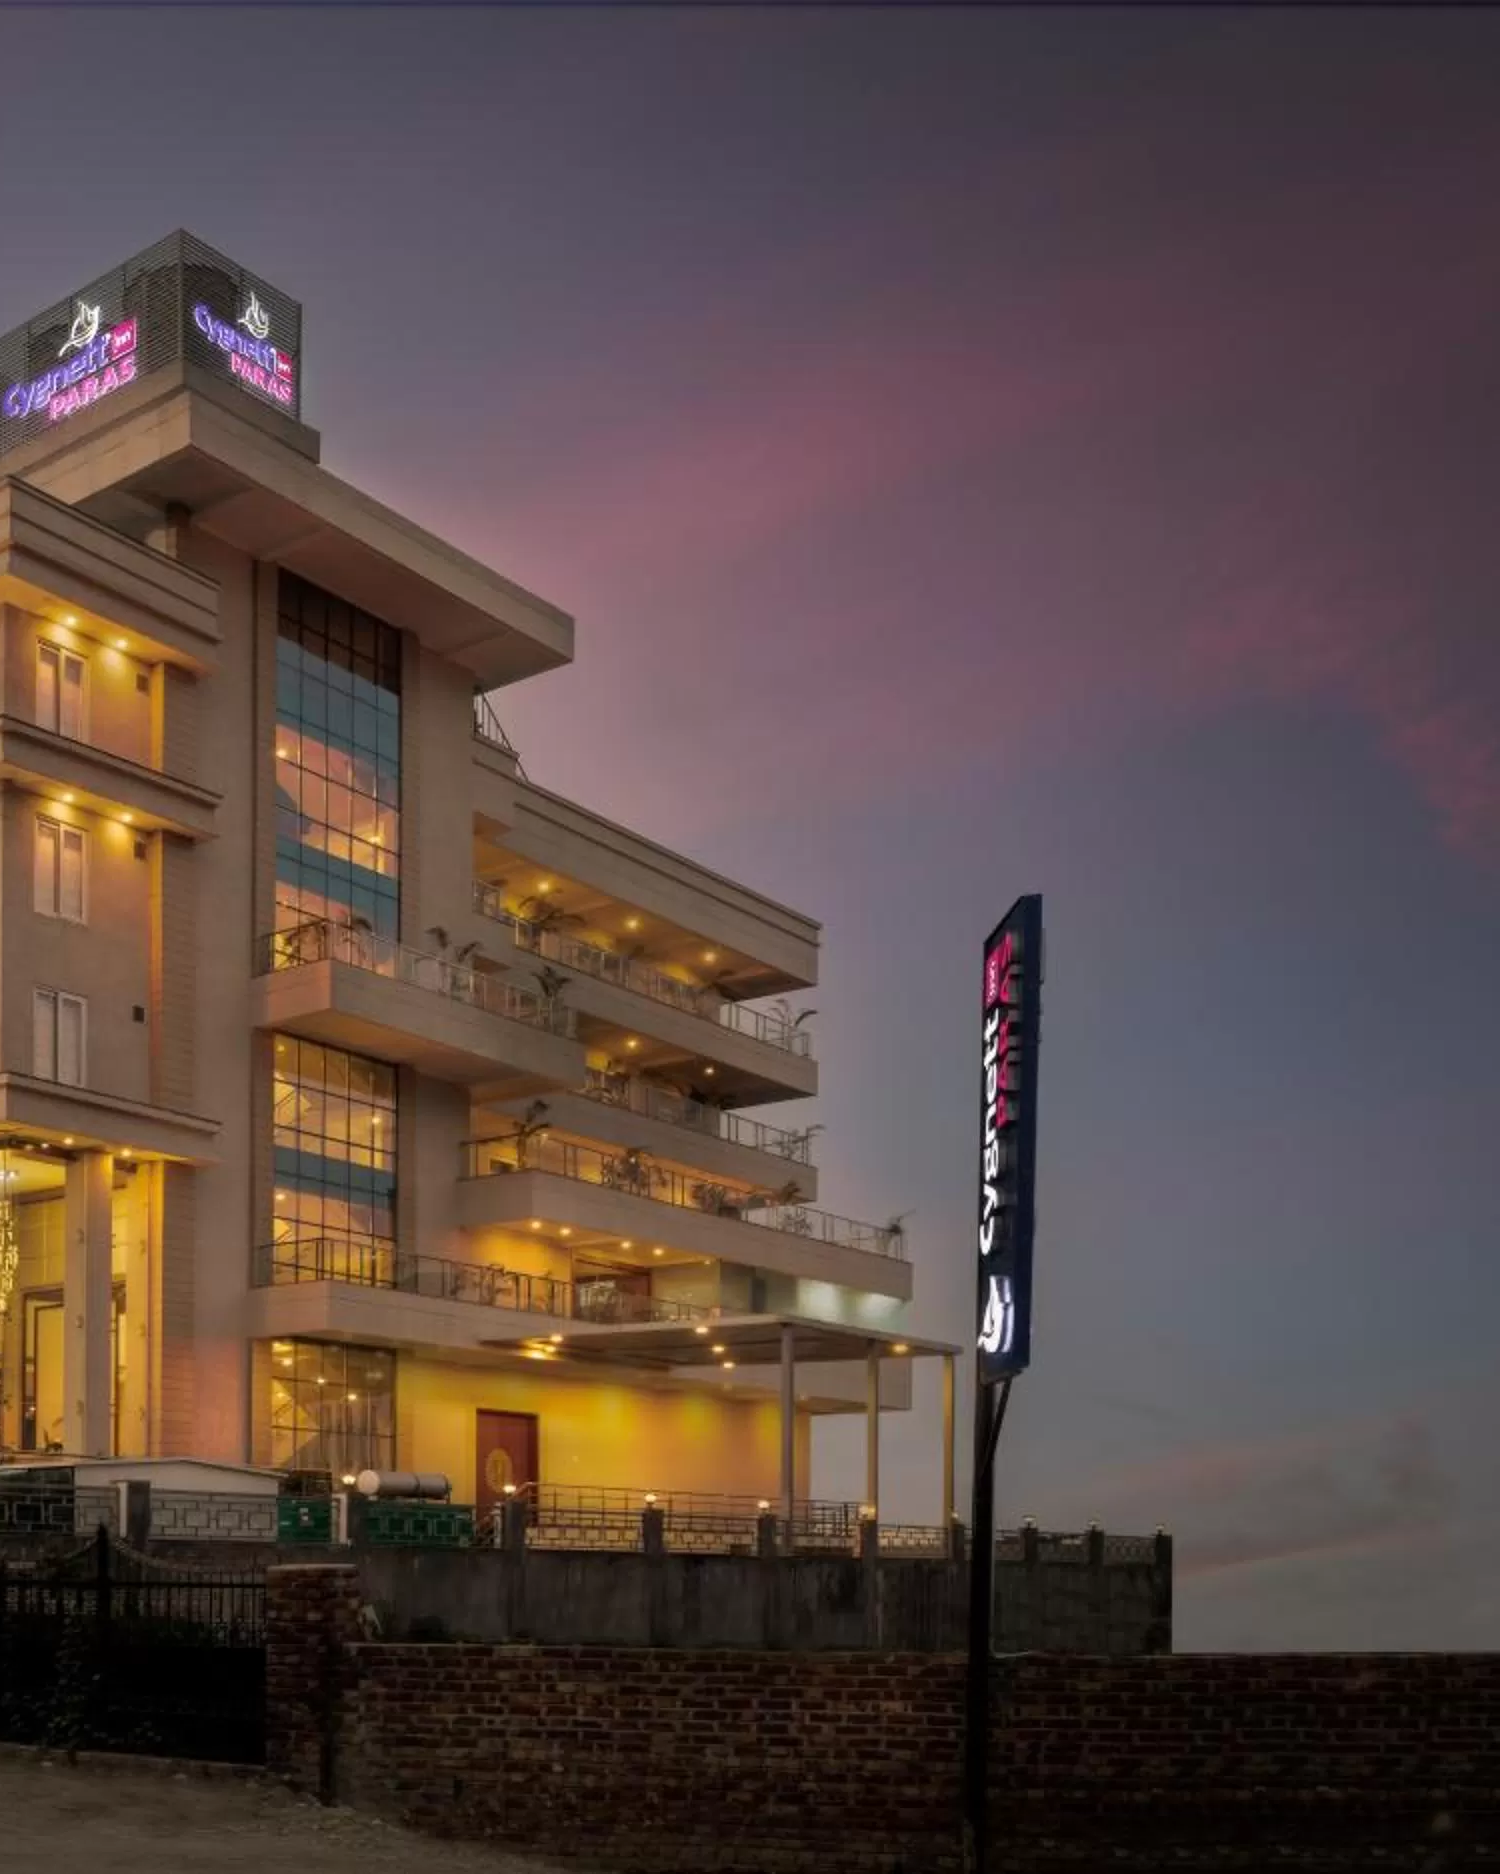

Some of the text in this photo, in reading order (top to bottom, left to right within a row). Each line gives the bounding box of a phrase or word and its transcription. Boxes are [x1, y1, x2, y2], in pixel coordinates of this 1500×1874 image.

[3, 332, 111, 418] Cygnett
[49, 355, 136, 422] PARAS
[231, 351, 293, 403] PARAS
